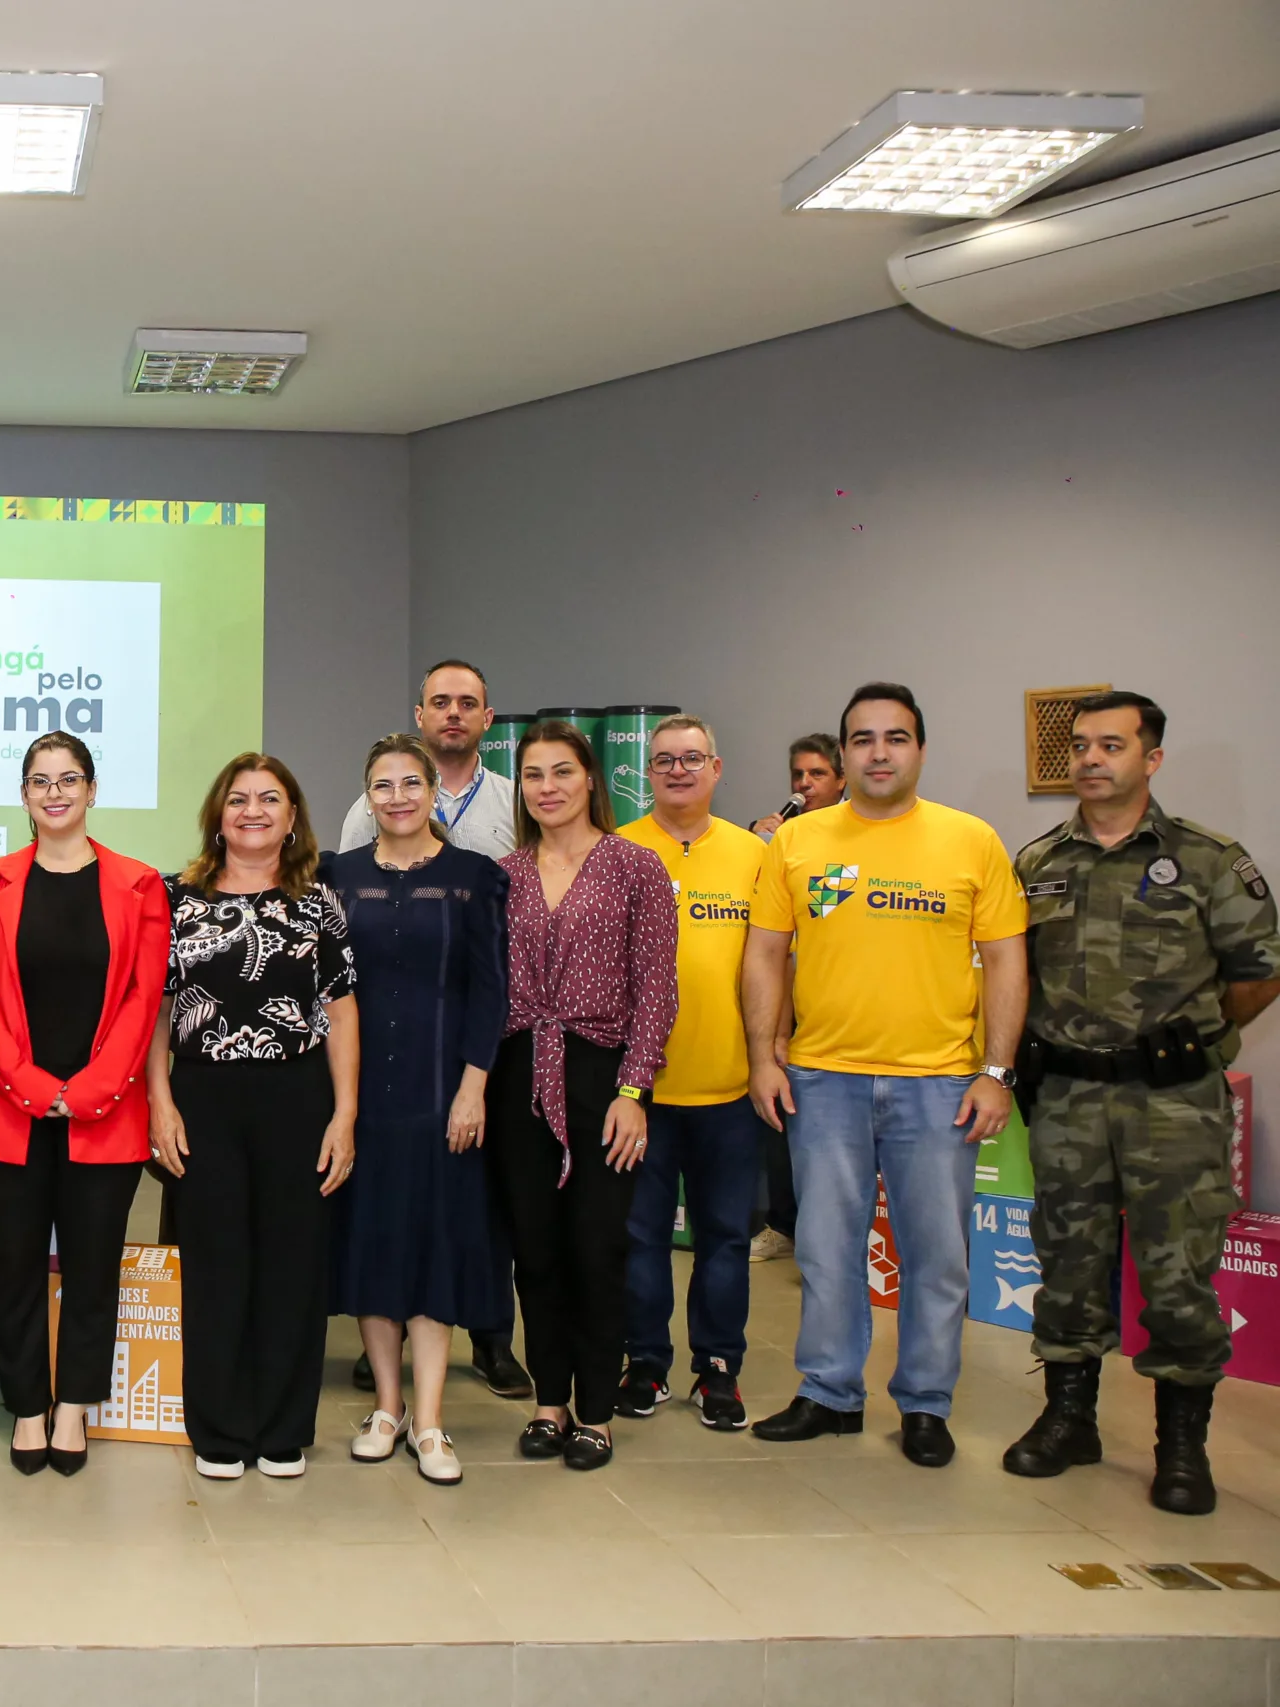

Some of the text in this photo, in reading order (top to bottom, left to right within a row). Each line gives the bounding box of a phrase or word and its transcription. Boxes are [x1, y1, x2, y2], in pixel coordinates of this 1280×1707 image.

[38, 666, 102, 695] pelo
[1, 743, 21, 759] de
[867, 878, 922, 890] Maringá
[688, 891, 731, 902] Maringá
[866, 891, 946, 914] Clima
[919, 889, 946, 900] pelo
[689, 903, 750, 920] Clima
[973, 1202, 998, 1233] 14
[1005, 1207, 1030, 1222] VIDA
[1006, 1222, 1032, 1239] ÁGUA
[1234, 1240, 1262, 1257] DAS
[142, 1288, 149, 1304] E
